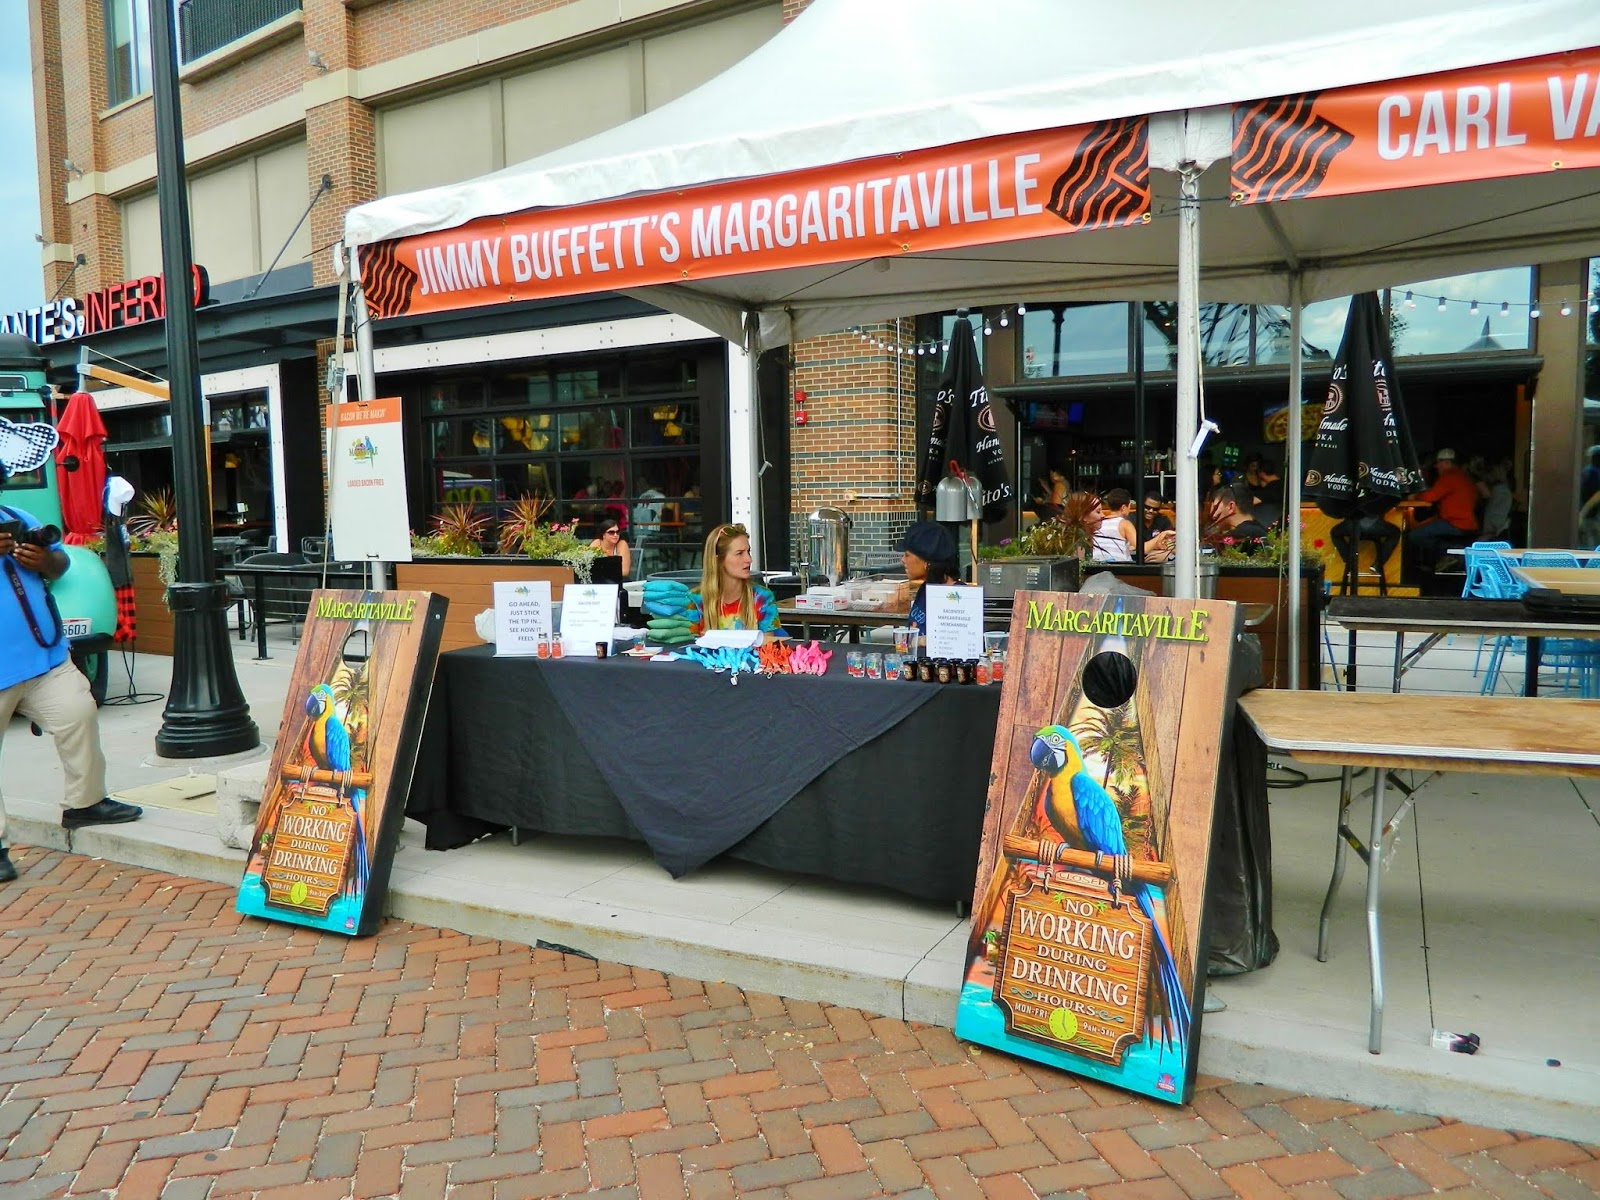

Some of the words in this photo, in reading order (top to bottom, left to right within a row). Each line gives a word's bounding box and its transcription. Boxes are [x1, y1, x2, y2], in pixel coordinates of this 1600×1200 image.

[1377, 82, 1527, 161] CARL
[415, 238, 501, 296] JIMMY
[510, 211, 681, 283] BUFFETT'S
[690, 153, 1044, 259] MARGARITAVILLE
[0, 297, 77, 344] ANTE'S
[83, 264, 201, 335] INFERO
[340, 411, 356, 422] BACON
[310, 805, 327, 816] NO
[282, 814, 347, 842] WORKING
[290, 839, 329, 853] DURING
[273, 849, 338, 875] DRINKING
[285, 872, 319, 885] HOURS
[1064, 898, 1094, 917] NO
[1019, 907, 1135, 960] WORKING
[1037, 944, 1107, 972] DURING
[1011, 956, 1129, 1007] DRINKING
[1015, 1002, 1048, 1019] MON-FRI
[1037, 991, 1096, 1016] HOURS
